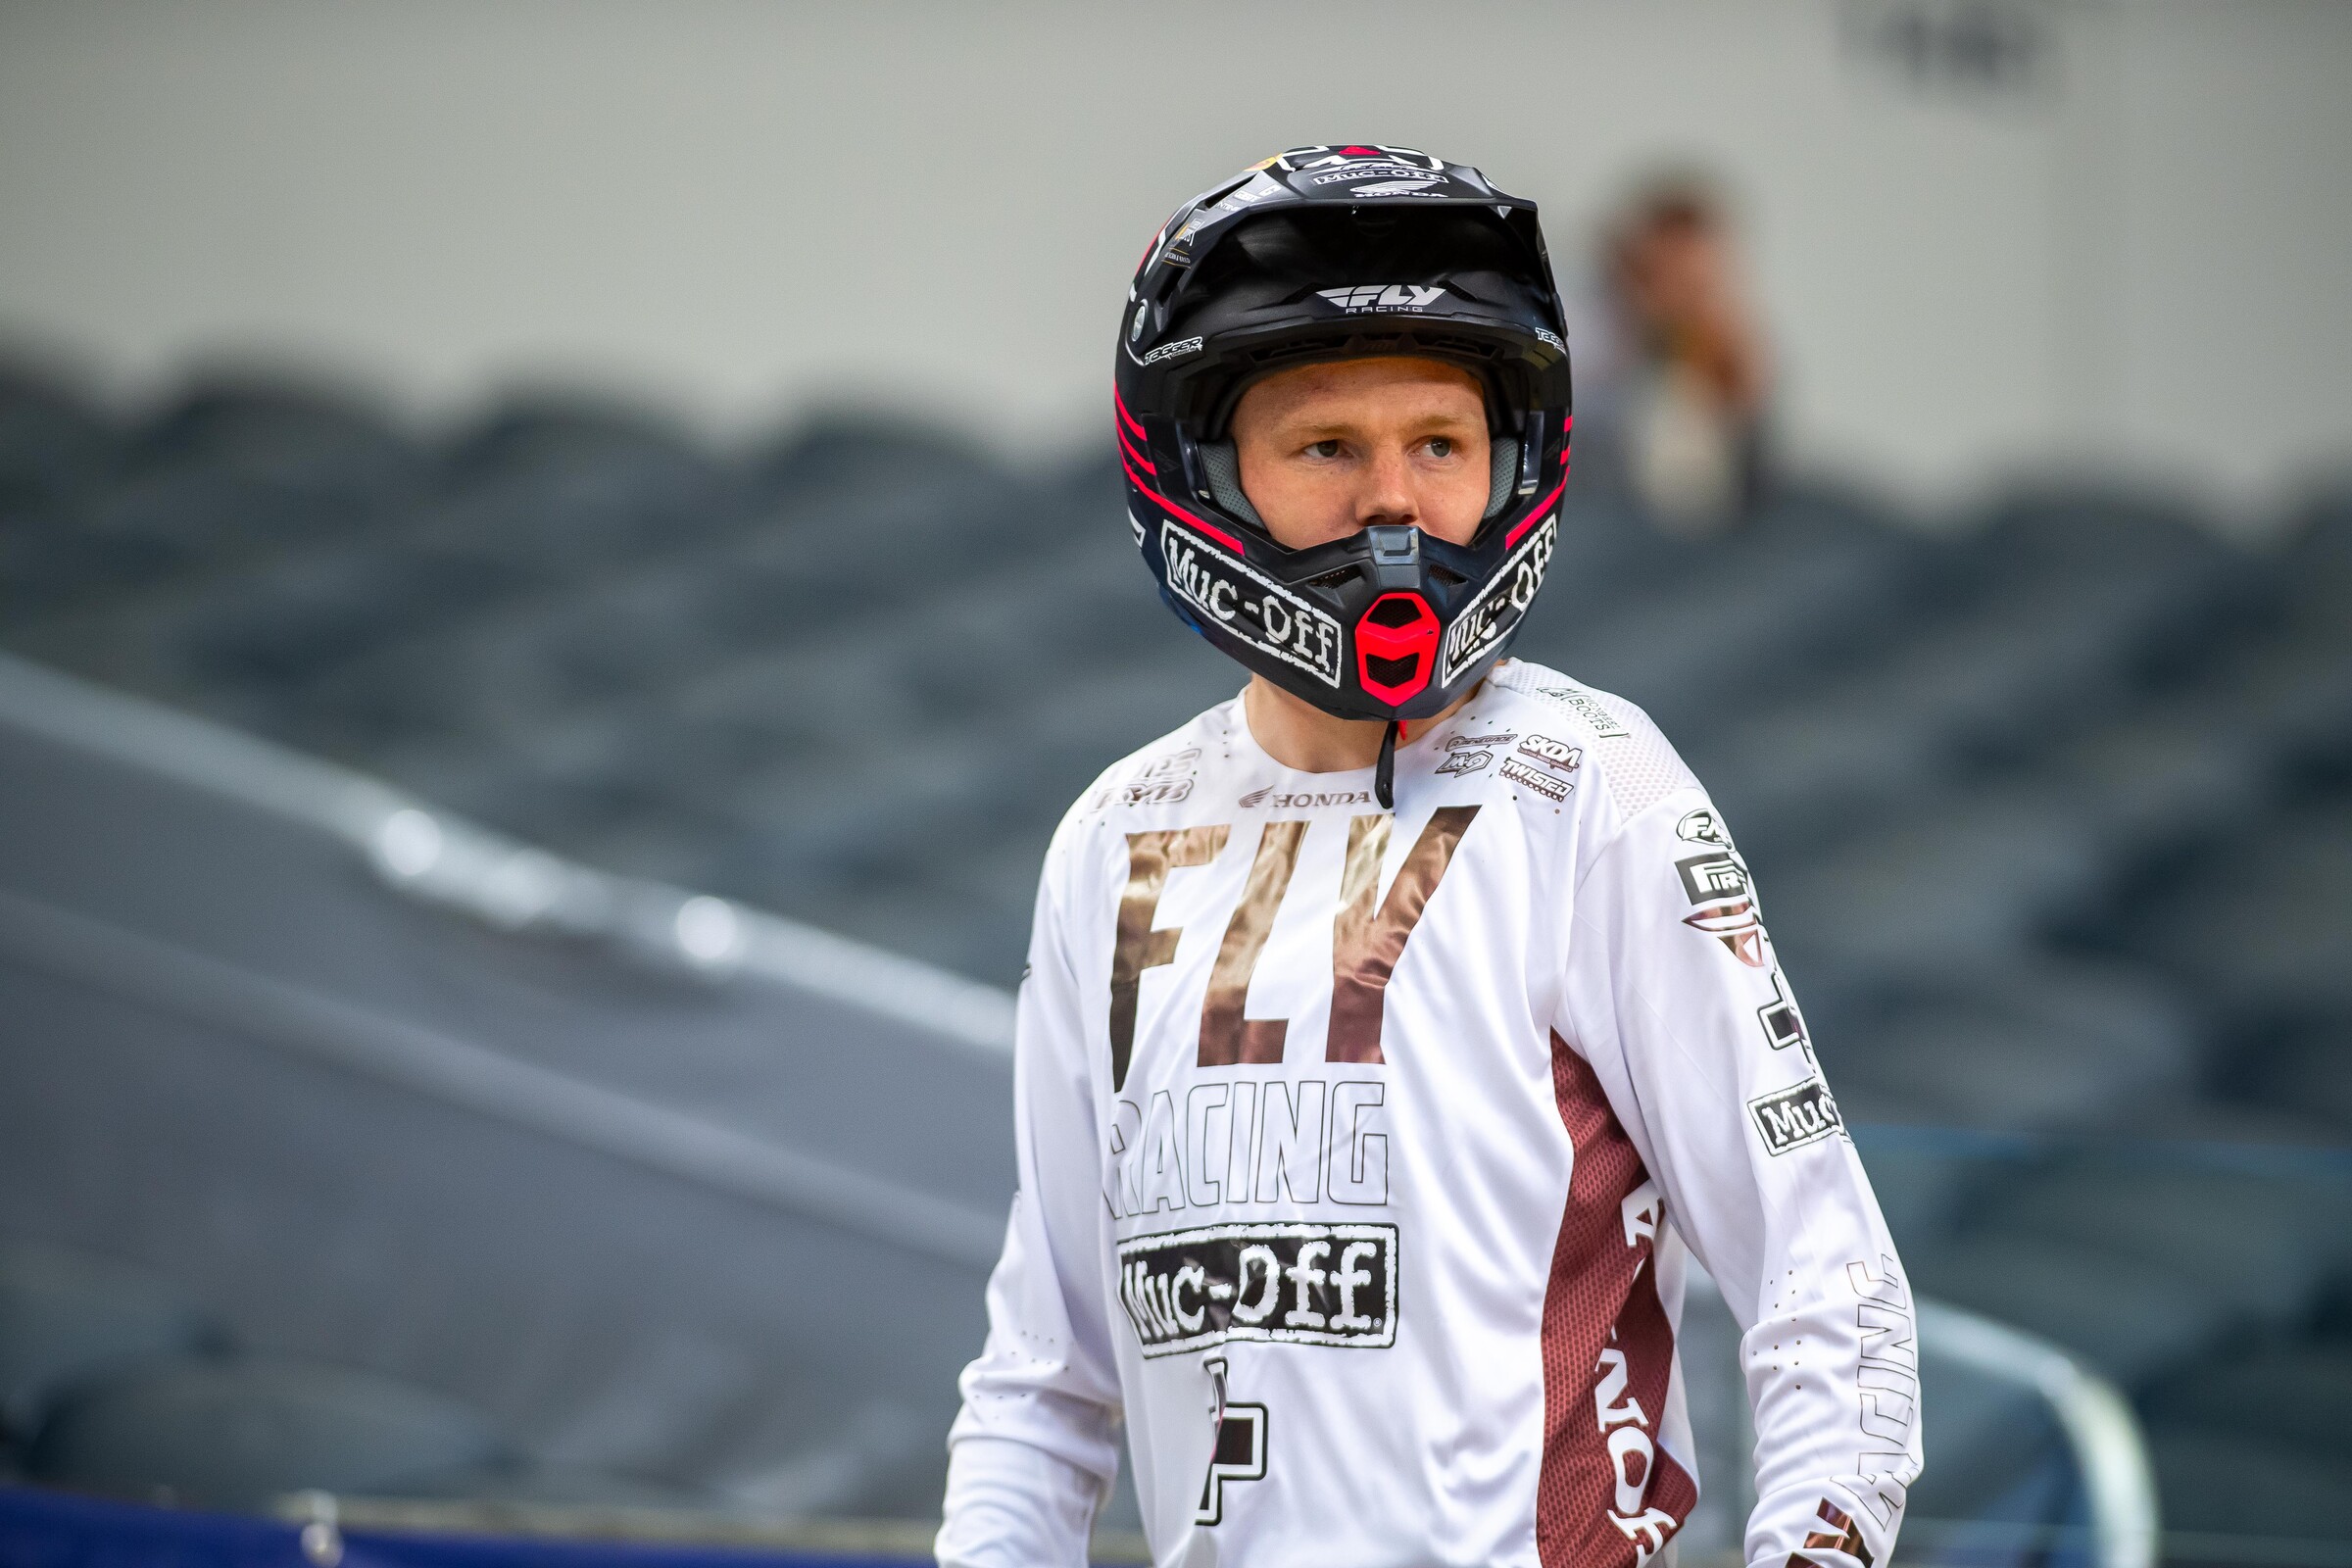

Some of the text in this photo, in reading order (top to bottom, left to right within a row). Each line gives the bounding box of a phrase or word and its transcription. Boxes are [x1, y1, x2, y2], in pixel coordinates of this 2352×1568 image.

[1315, 284, 1446, 308] FLY
[1568, 698, 1610, 731] BOOTS
[1519, 734, 1583, 768] SKDA
[1501, 759, 1574, 798] TWISTED
[1272, 790, 1372, 808] HONDA
[1109, 804, 1483, 1095] FLY
[1102, 1080, 1389, 1220] RACING
